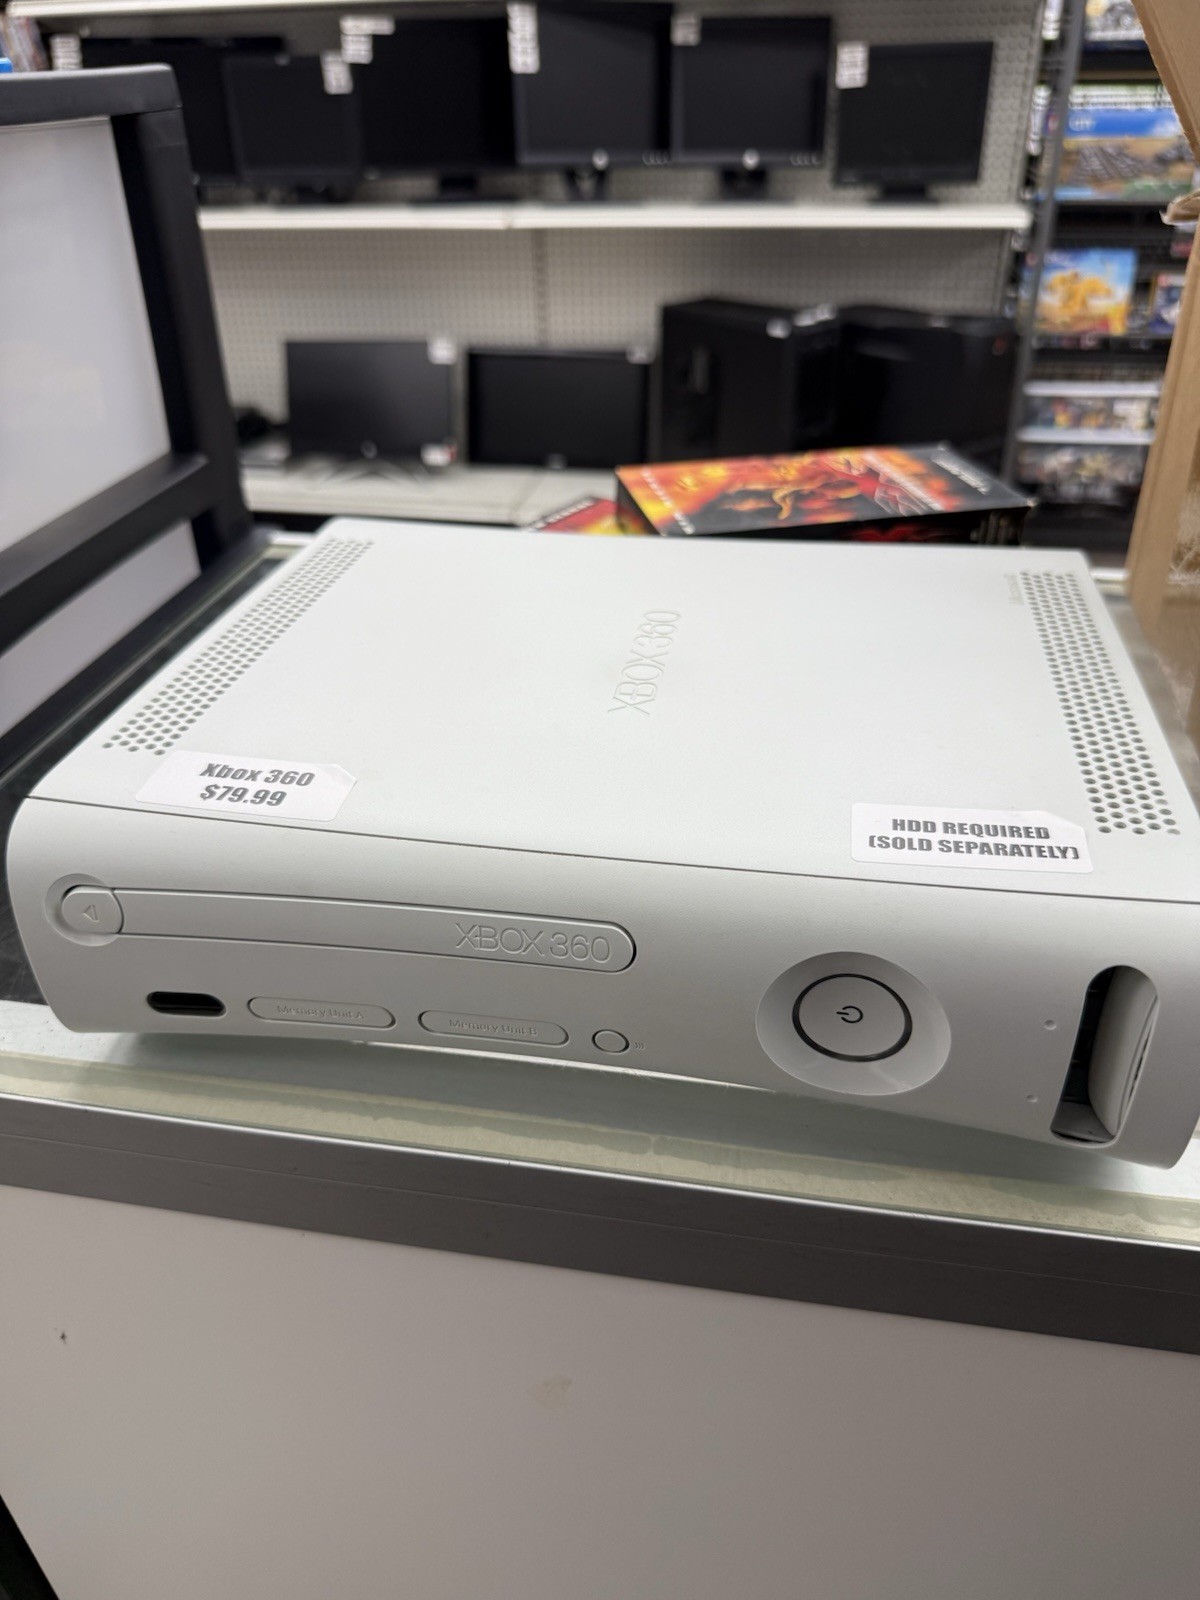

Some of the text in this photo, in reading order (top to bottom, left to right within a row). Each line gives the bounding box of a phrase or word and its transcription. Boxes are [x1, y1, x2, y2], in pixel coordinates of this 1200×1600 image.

[199, 762, 316, 787] Xbox 360
[200, 784, 288, 806] $79.99
[892, 818, 1050, 839] HDD REQUIRED
[868, 835, 1080, 859] (SOLD SEPARATELY)
[455, 922, 611, 963] XBOX 360
[277, 1005, 364, 1019] Memory Unit A
[449, 1019, 538, 1036] Memory Unit B
